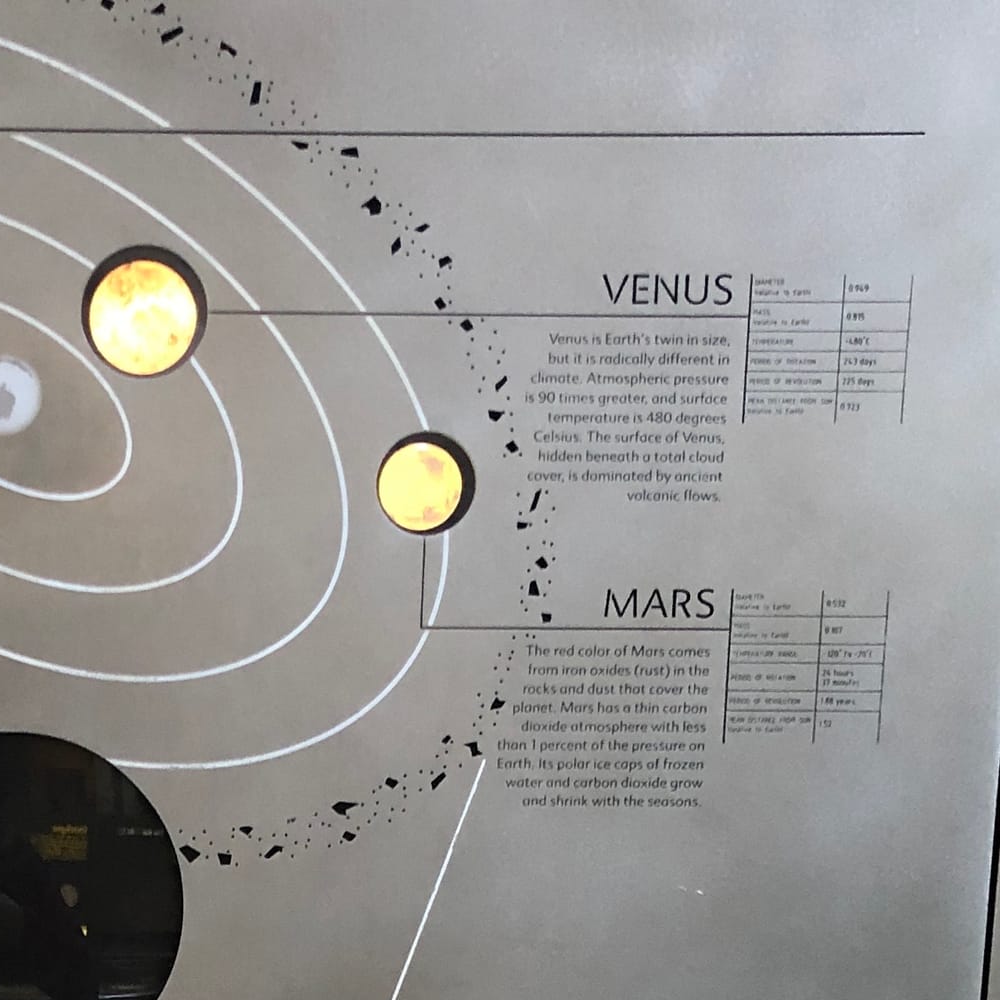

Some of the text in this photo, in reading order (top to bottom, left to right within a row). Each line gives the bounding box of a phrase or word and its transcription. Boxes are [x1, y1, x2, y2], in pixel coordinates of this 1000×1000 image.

[602, 273, 734, 306] VENUS
[549, 333, 730, 349] Venus is Earth's twin in size,
[548, 352, 729, 367] but it is radically different in
[548, 411, 726, 427] temperature is 480 degrees
[538, 450, 724, 463] hidden beneath a total cloud
[627, 489, 720, 502] volcanic flows.
[603, 588, 716, 620] MARS
[526, 644, 710, 658] The red color of Mars comes
[528, 663, 709, 679] from iron oxides (rust) in the
[522, 794, 701, 808] and shrink with the seasons.
